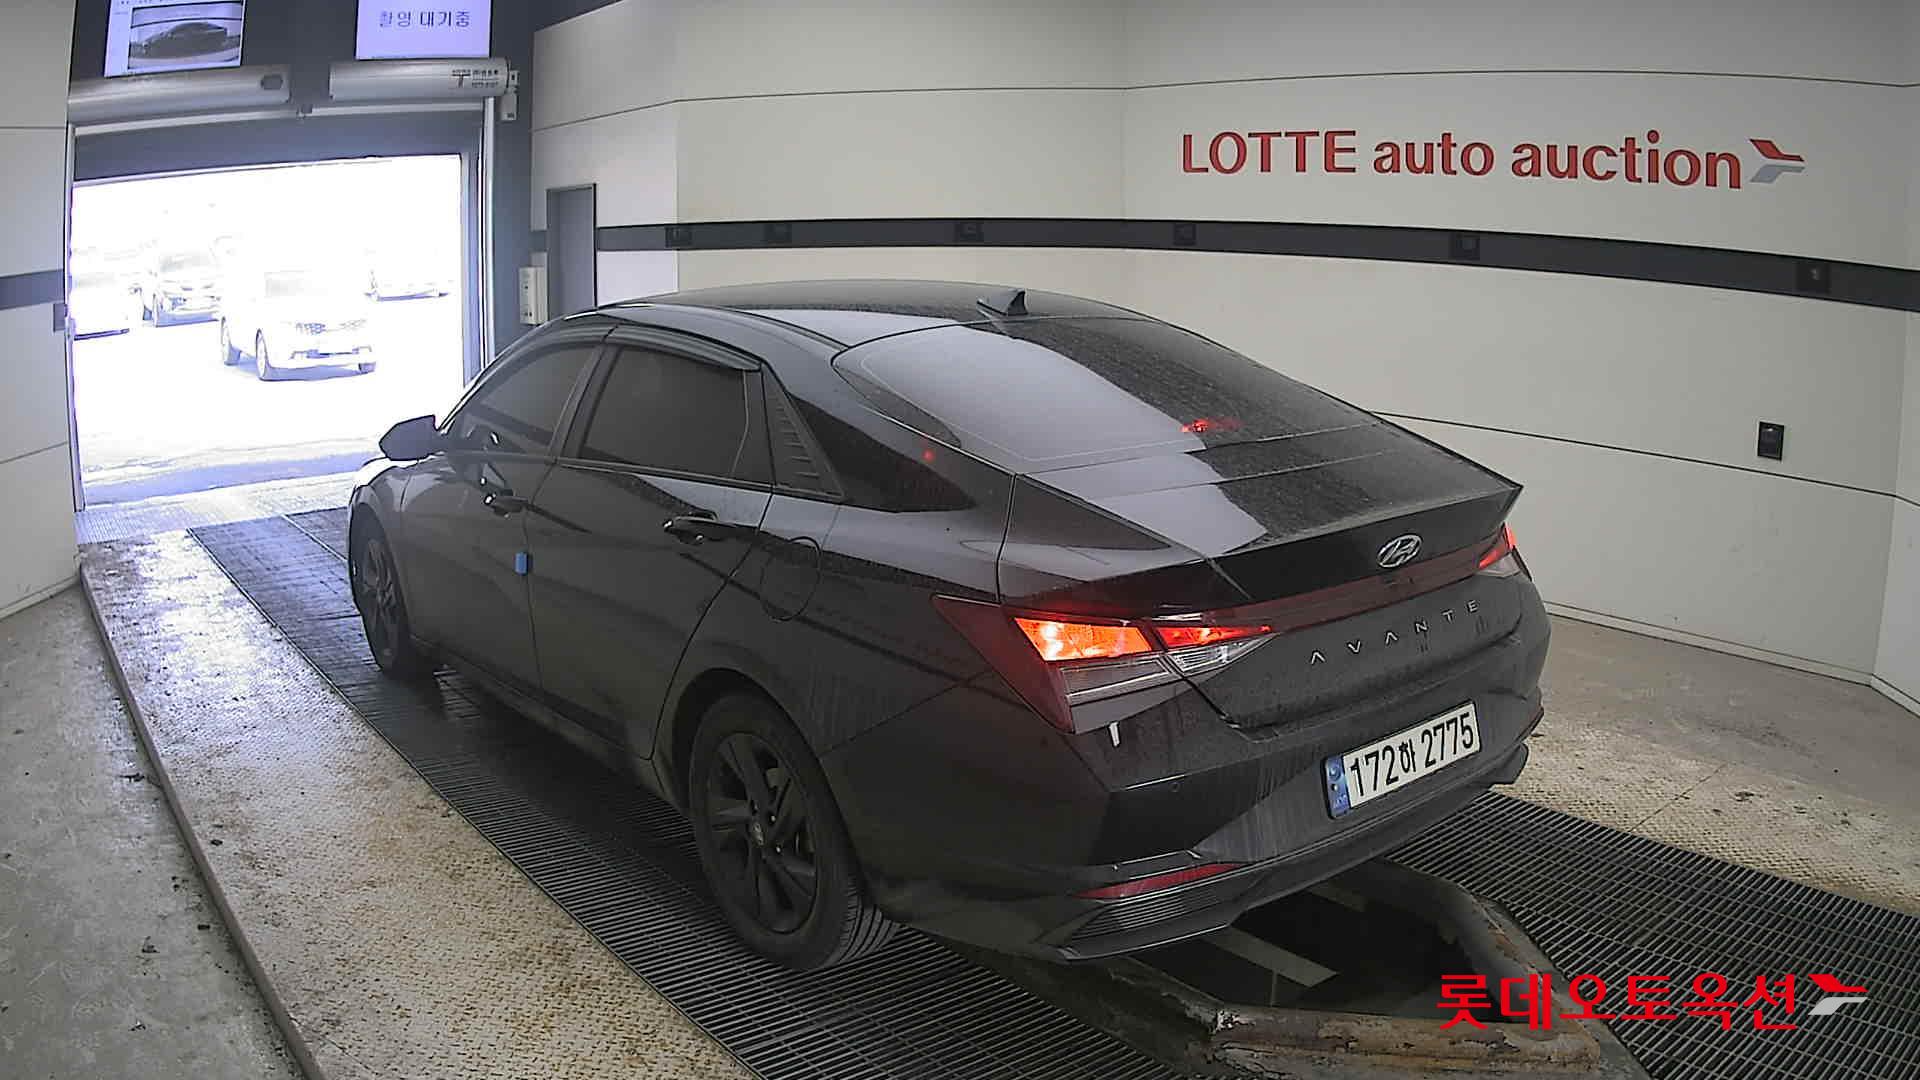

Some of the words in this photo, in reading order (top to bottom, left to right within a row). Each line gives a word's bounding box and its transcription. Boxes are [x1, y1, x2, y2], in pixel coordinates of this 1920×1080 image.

[419, 10, 471, 28] 대기중
[1183, 130, 1357, 174] LOTTE
[1373, 132, 1495, 177] auto
[1511, 129, 1743, 189] auction
[1310, 600, 1479, 665] AVANTE
[1350, 739, 1416, 797] 172하
[1421, 711, 1474, 769] 2775
